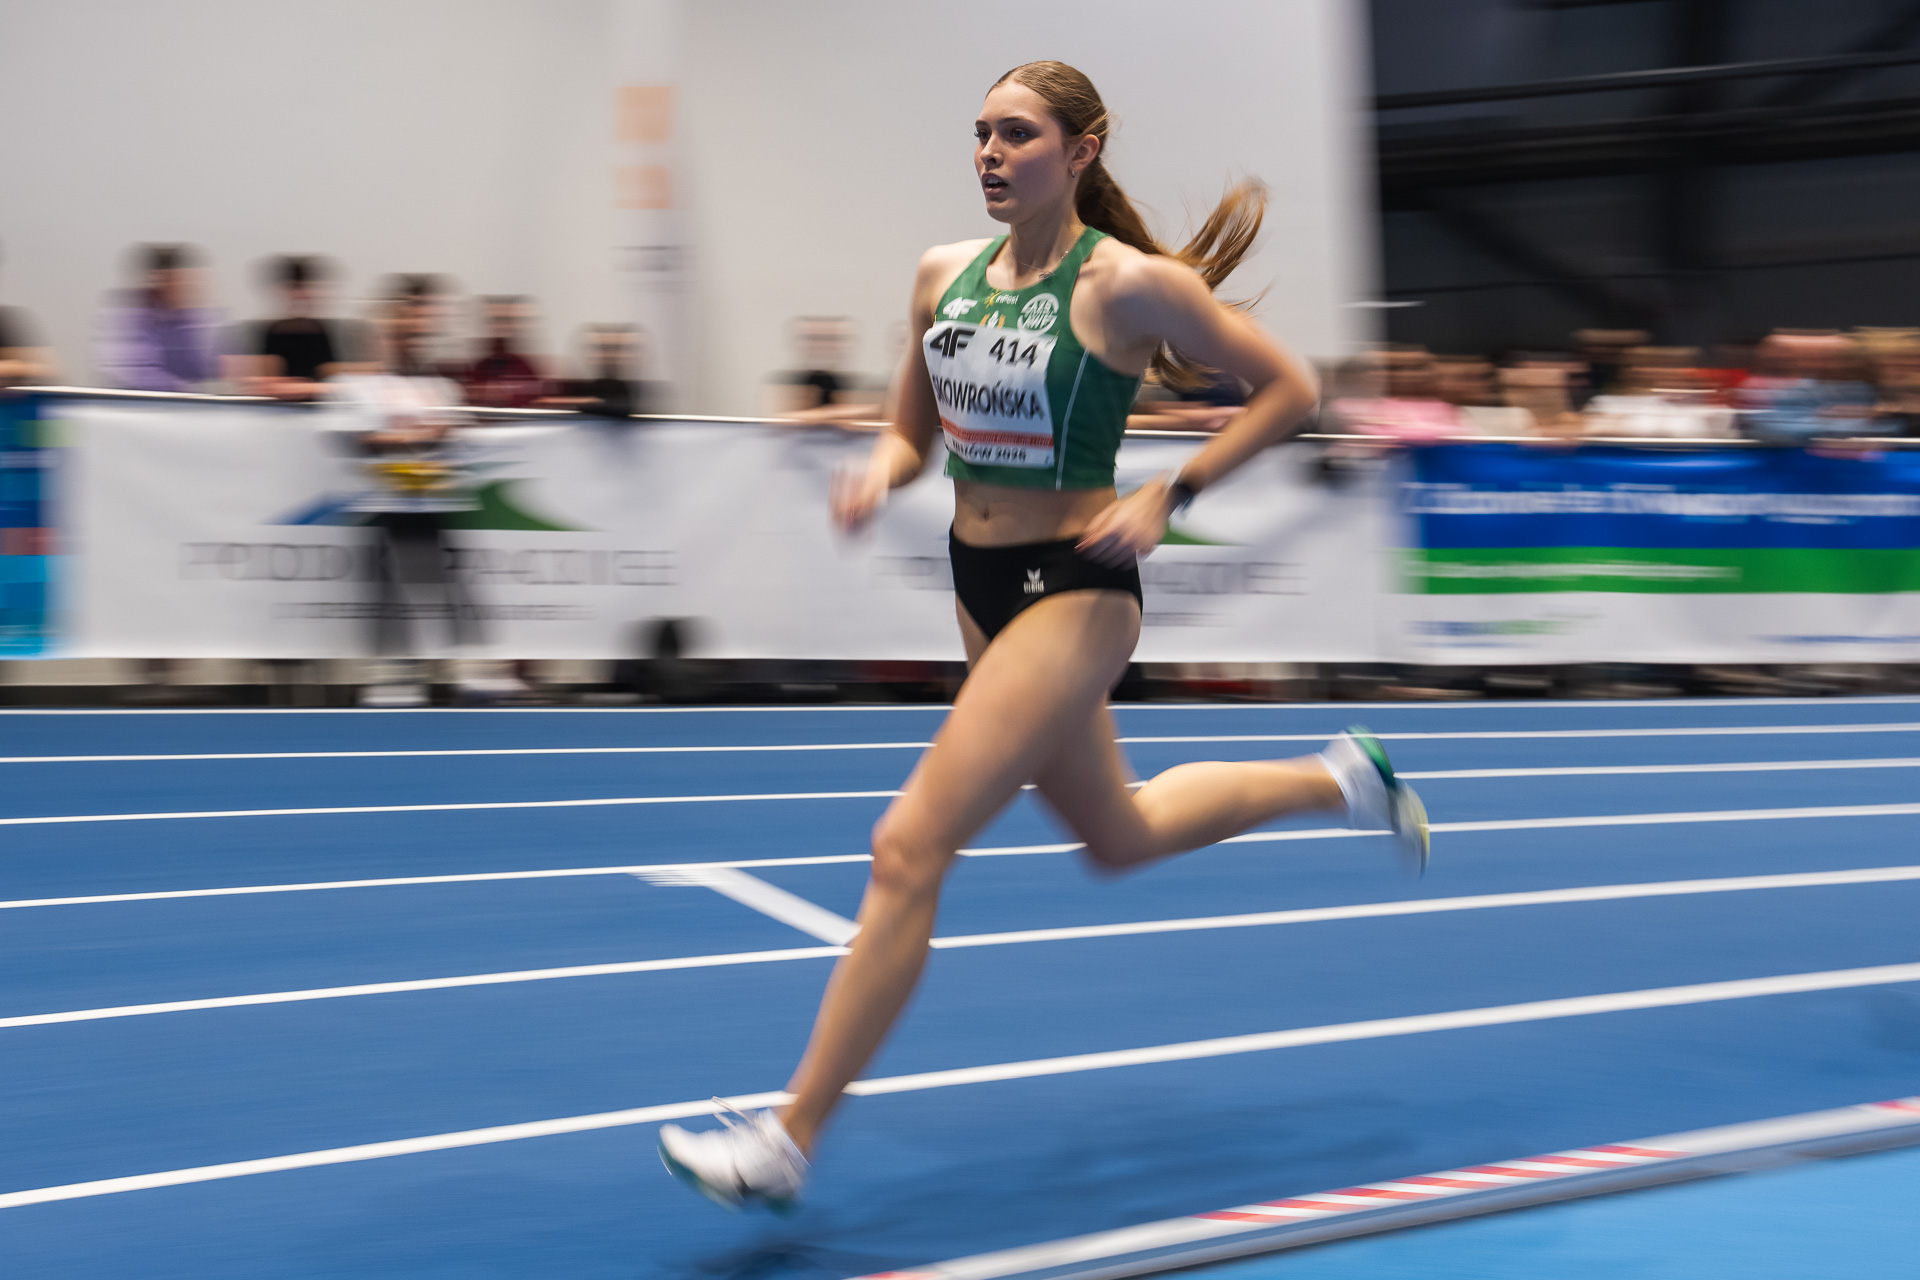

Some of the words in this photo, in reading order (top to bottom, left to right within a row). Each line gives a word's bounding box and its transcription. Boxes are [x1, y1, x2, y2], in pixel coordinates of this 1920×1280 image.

[943, 297, 978, 320] 4F
[930, 327, 976, 359] 4F
[989, 336, 1039, 370] 414
